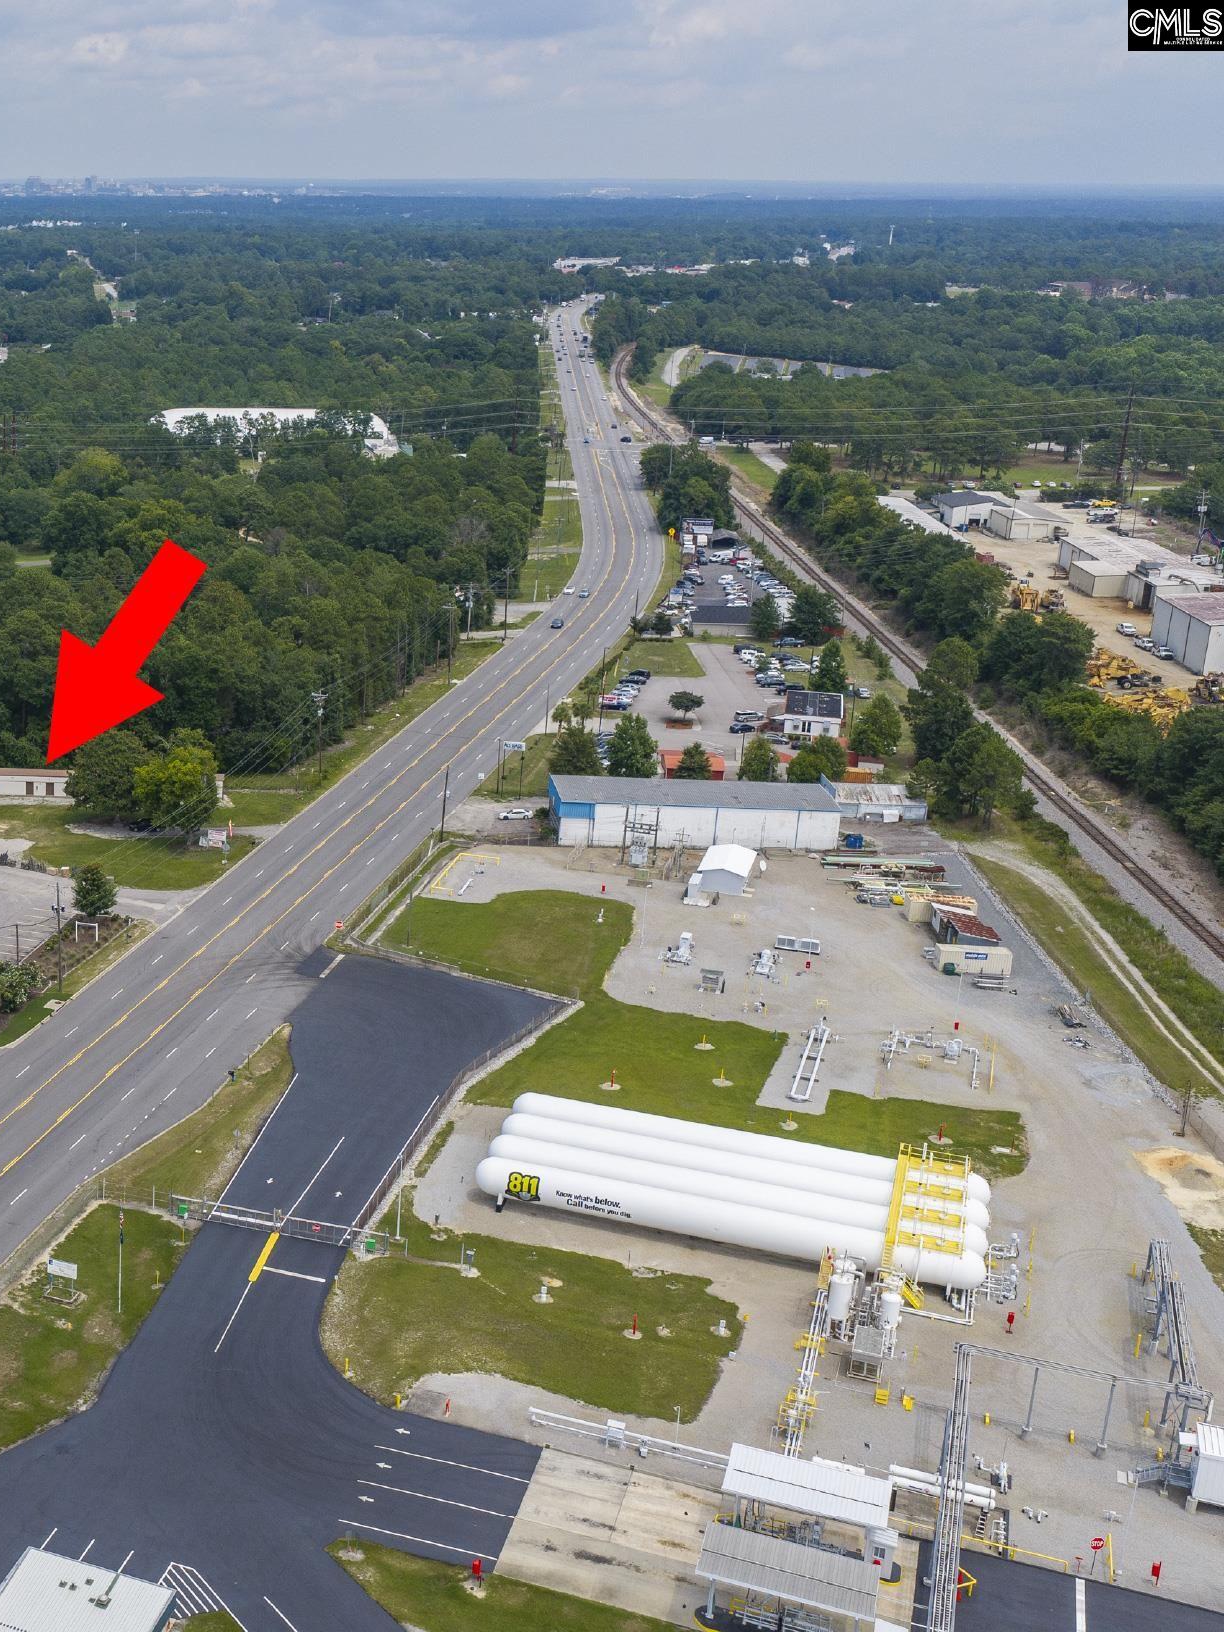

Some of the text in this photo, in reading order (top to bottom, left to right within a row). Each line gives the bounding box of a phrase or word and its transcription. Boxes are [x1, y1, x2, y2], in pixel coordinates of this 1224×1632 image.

[508, 1172, 540, 1197] 811
[555, 1190, 621, 1209] Know what's below.
[566, 1198, 583, 1209] Call
[584, 1203, 606, 1213] before
[606, 1208, 619, 1216] you
